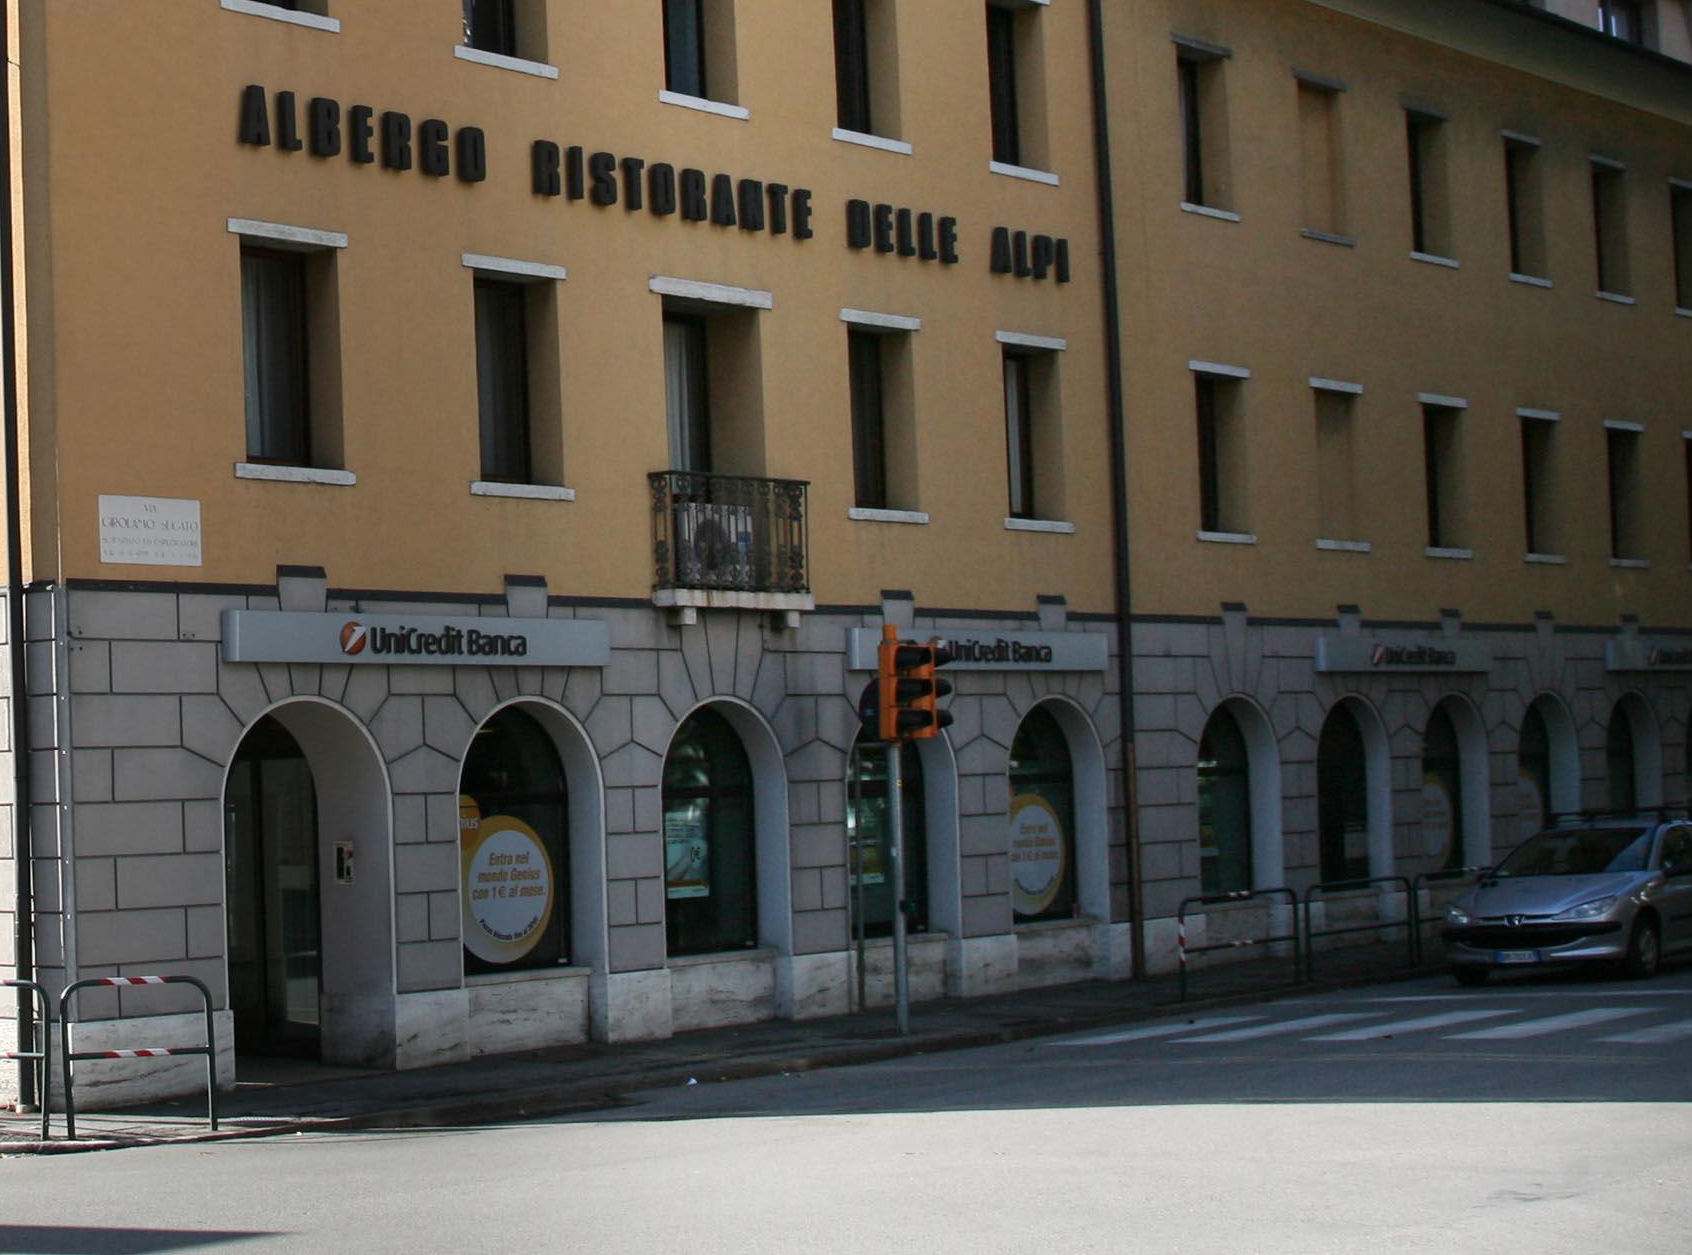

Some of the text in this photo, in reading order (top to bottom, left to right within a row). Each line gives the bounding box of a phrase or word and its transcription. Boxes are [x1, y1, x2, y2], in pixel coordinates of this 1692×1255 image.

[239, 84, 1071, 284] ALBERGO RISTORANTE DELLE ALPI
[141, 504, 157, 513] VIA
[371, 625, 527, 656] UniCredit Banca
[1011, 641, 1052, 663] Banca
[490, 850, 529, 866] Entra nel
[510, 867, 541, 881] Genius
